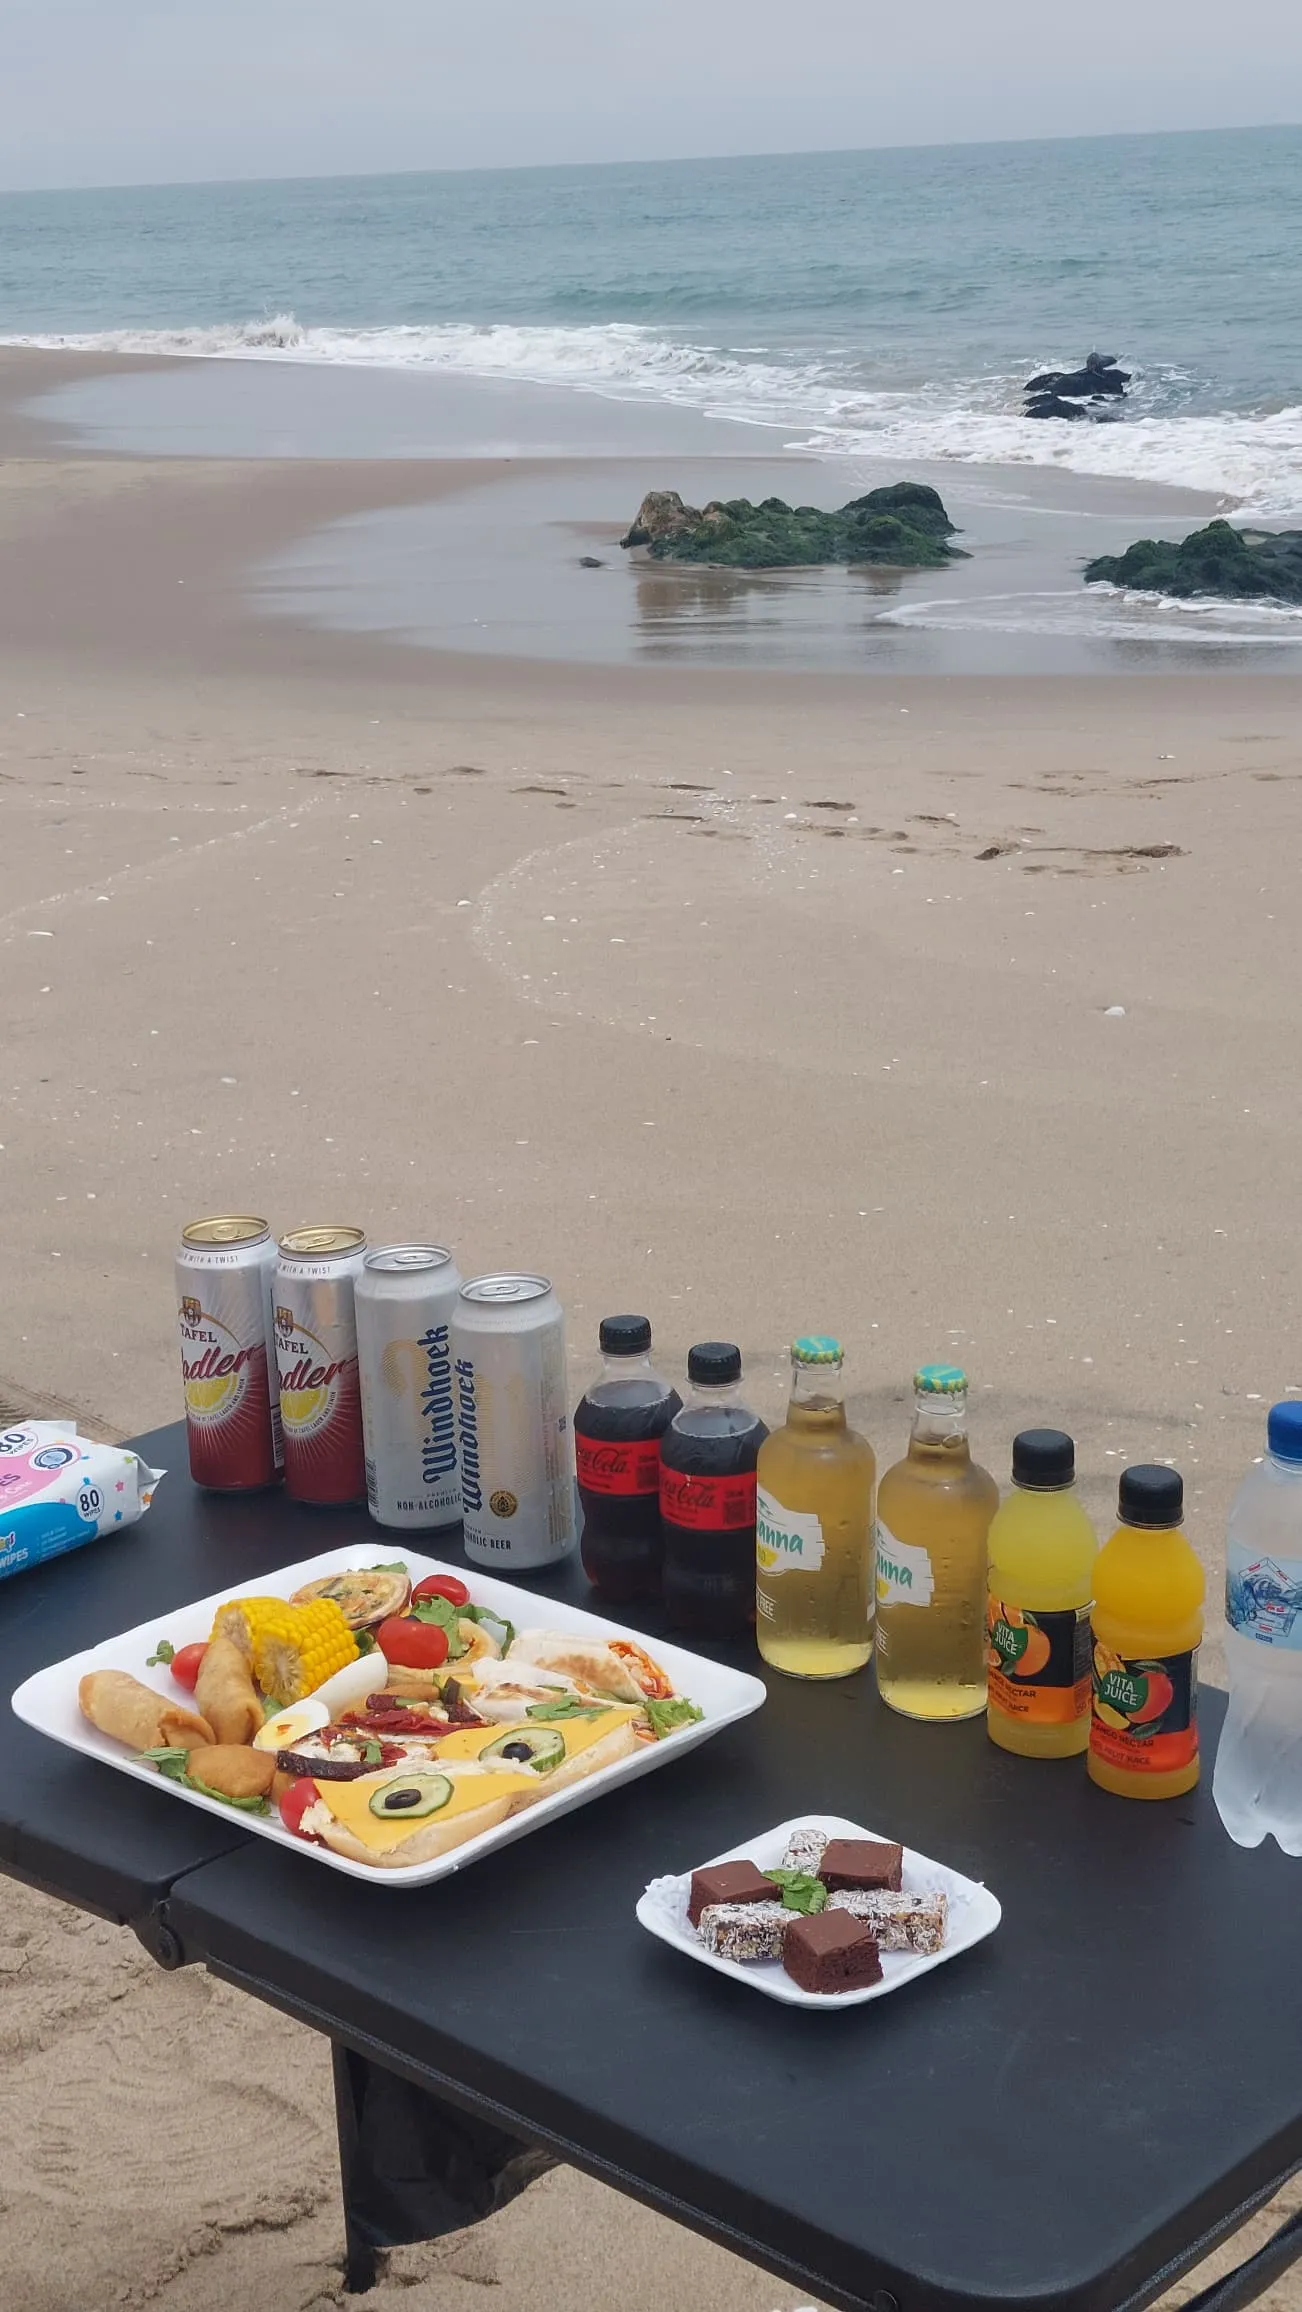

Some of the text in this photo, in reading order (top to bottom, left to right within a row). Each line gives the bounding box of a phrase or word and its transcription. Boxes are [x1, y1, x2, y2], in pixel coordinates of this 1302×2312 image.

[215, 1255, 238, 1264] TWIST
[308, 1266, 330, 1275] TWIST
[180, 1323, 217, 1343] TAFEL
[182, 1342, 266, 1380] adler
[417, 1324, 458, 1484] Windhoek
[80, 1489, 99, 1512] 80
[490, 1538, 511, 1550] BEER
[757, 1519, 804, 1556] anna
[998, 1622, 1014, 1642] VITA
[995, 1631, 1018, 1656] JUICE
[1110, 1673, 1134, 1693] VITA
[1104, 1683, 1138, 1706] JUICE
